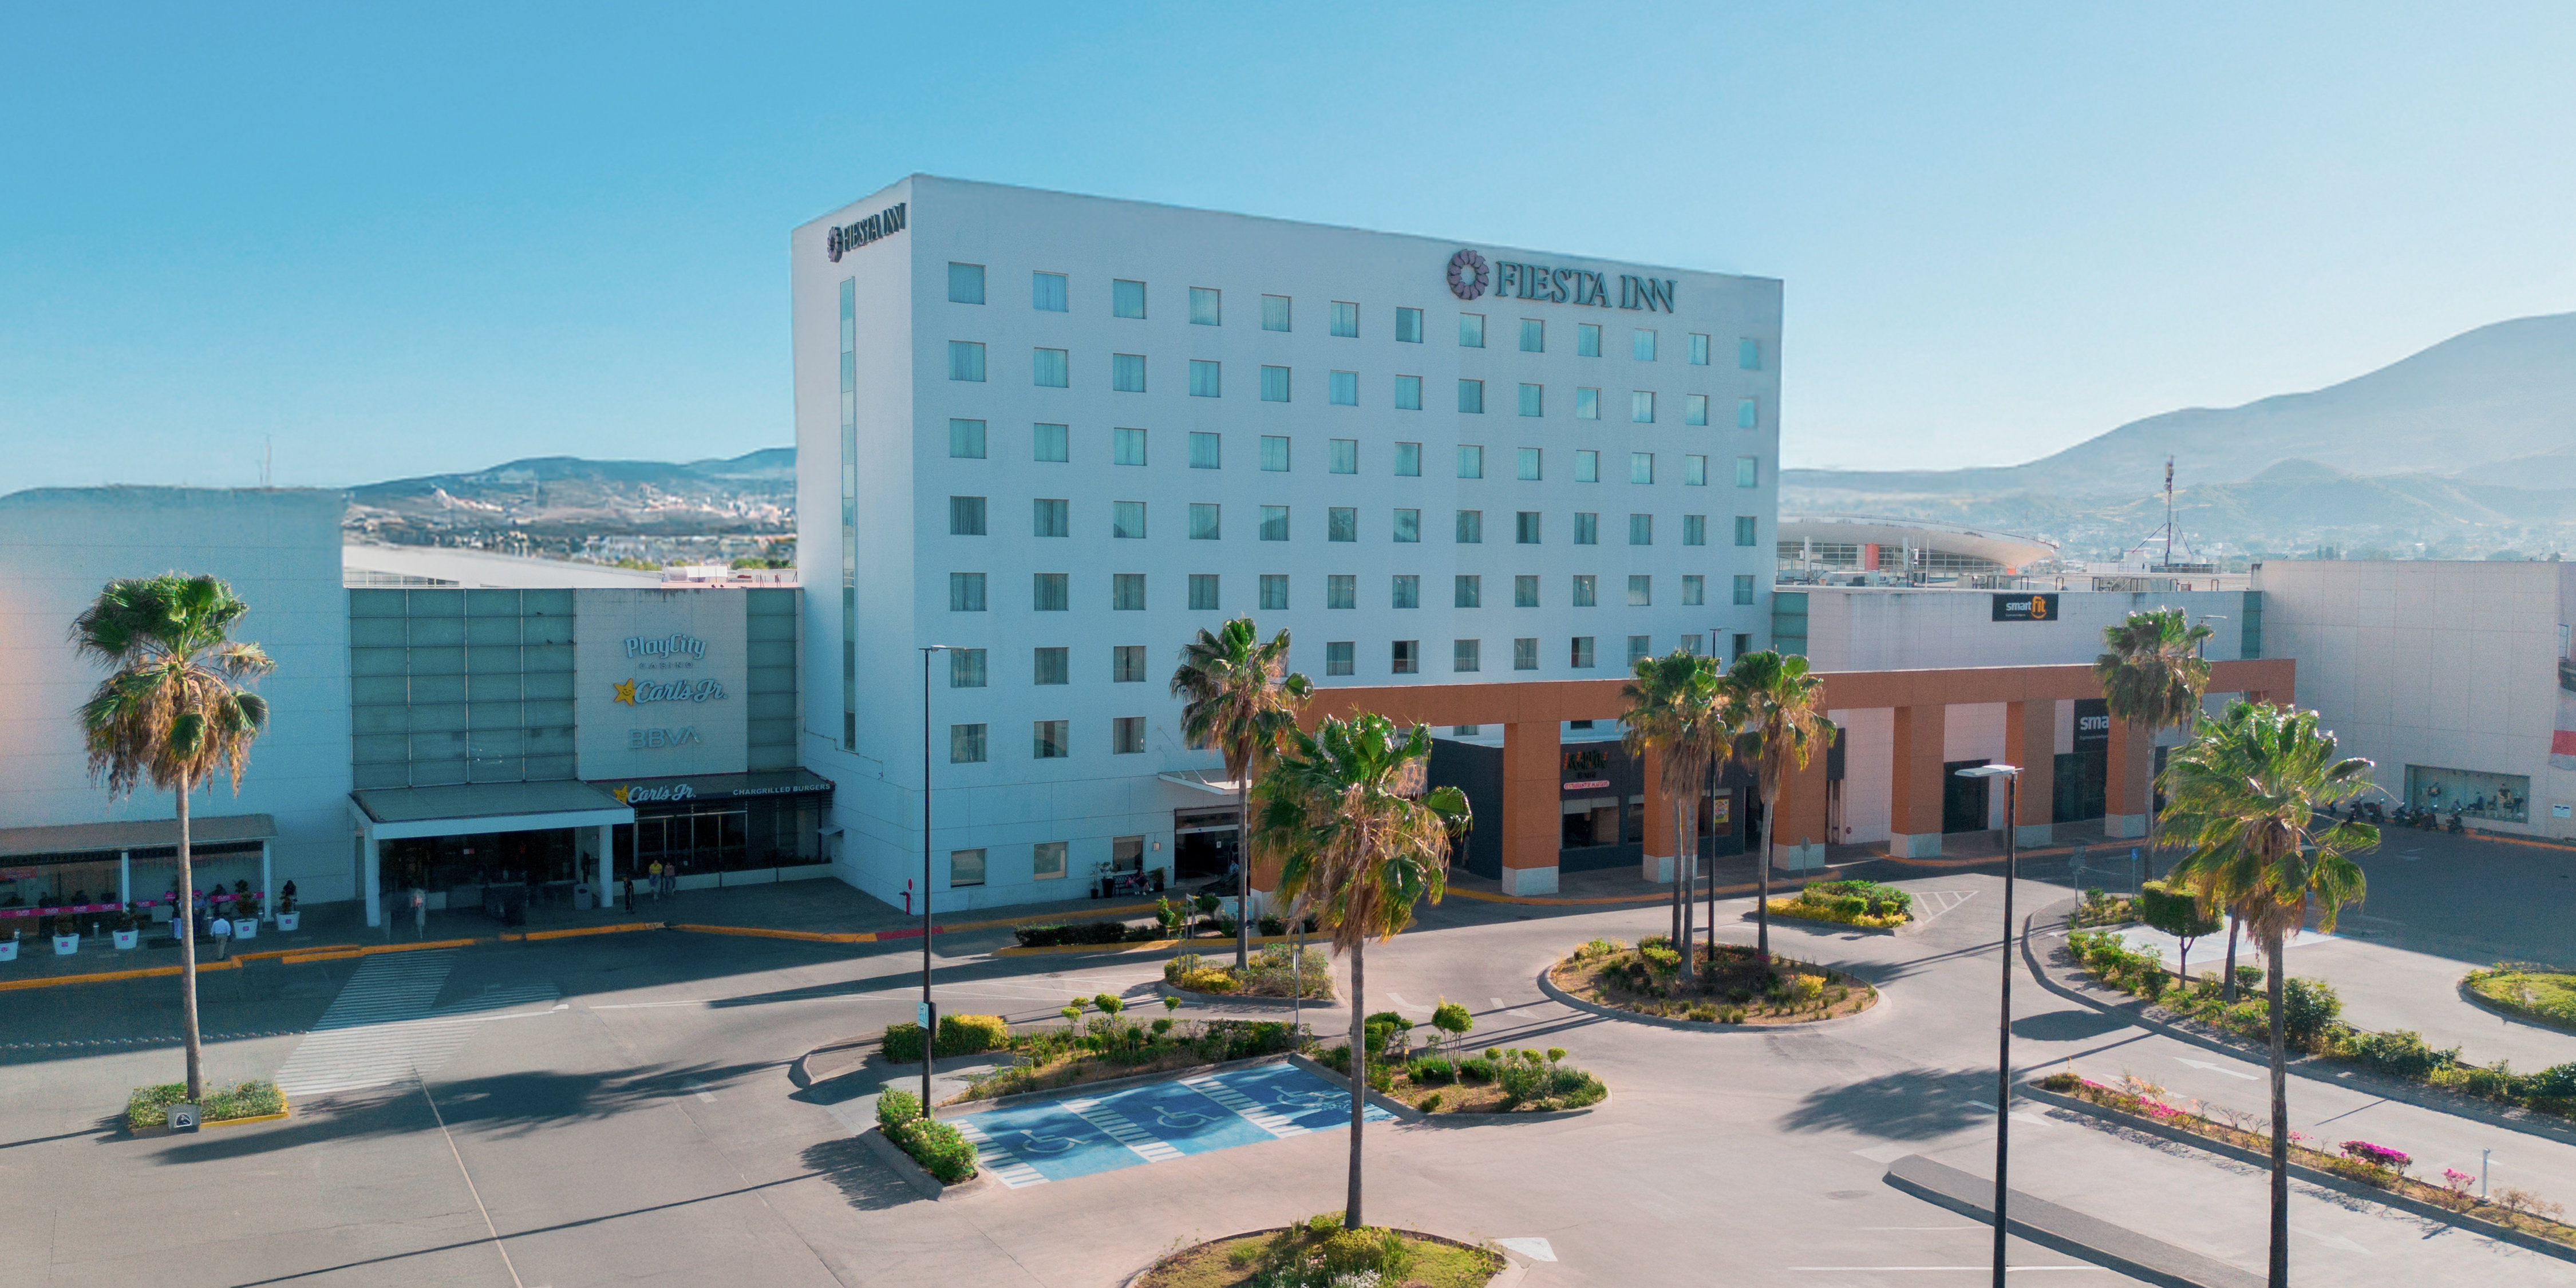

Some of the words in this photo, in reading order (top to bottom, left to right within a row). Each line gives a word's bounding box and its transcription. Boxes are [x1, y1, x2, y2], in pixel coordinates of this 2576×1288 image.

[843, 214, 883, 252] FIESTA
[882, 203, 906, 236] INN
[1495, 260, 1613, 308] FIESTA
[1619, 274, 1678, 314] INN
[2006, 601, 2032, 611] smart
[2032, 595, 2046, 613] fit
[625, 634, 706, 659] PlayCity
[634, 679, 693, 704] Carl's
[693, 679, 728, 702] Jr.
[2080, 716, 2109, 730] sma
[629, 725, 701, 749] BBVA
[627, 785, 671, 803] Carl's
[671, 784, 697, 800] Jr.
[733, 787, 791, 796] CHARGRILLED
[793, 784, 830, 792] BURGERS
